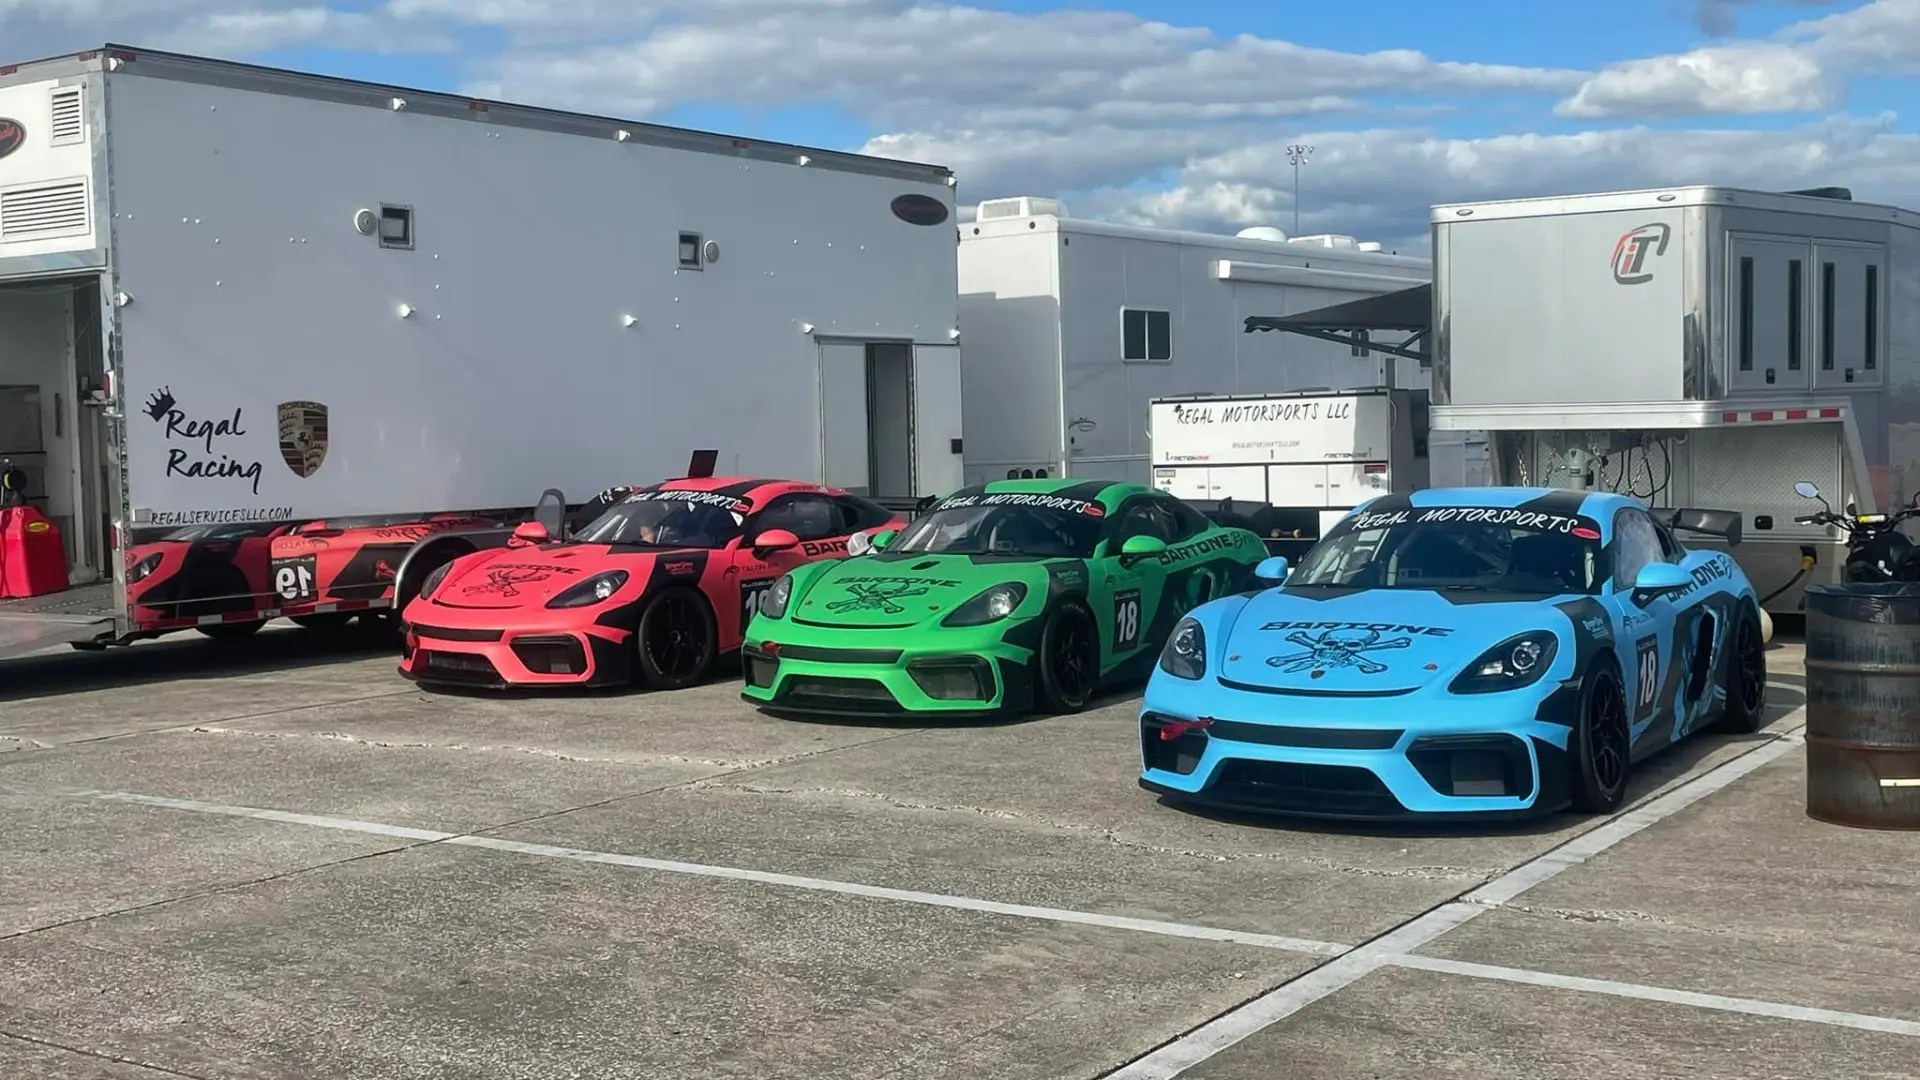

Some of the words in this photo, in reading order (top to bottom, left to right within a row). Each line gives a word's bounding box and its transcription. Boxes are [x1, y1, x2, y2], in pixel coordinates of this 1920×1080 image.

[1176, 405, 1214, 425] REGAL
[1221, 403, 1320, 423] MOTORSPORTS
[1326, 402, 1350, 420] LLC
[165, 407, 246, 454] Regal
[165, 448, 263, 495] Racing
[653, 490, 742, 510] MOTORSPORTS
[980, 493, 1090, 514] MOTORSPORTS
[150, 506, 293, 526] REGALSERVICESLLC.COM
[1351, 509, 1411, 531] REGAL
[1416, 507, 1579, 534] MOTORSPORTS
[832, 576, 963, 588] BARTONE
[1116, 600, 1139, 643] 18
[1258, 620, 1456, 637] BARTONE
[1639, 650, 1656, 708] 18
